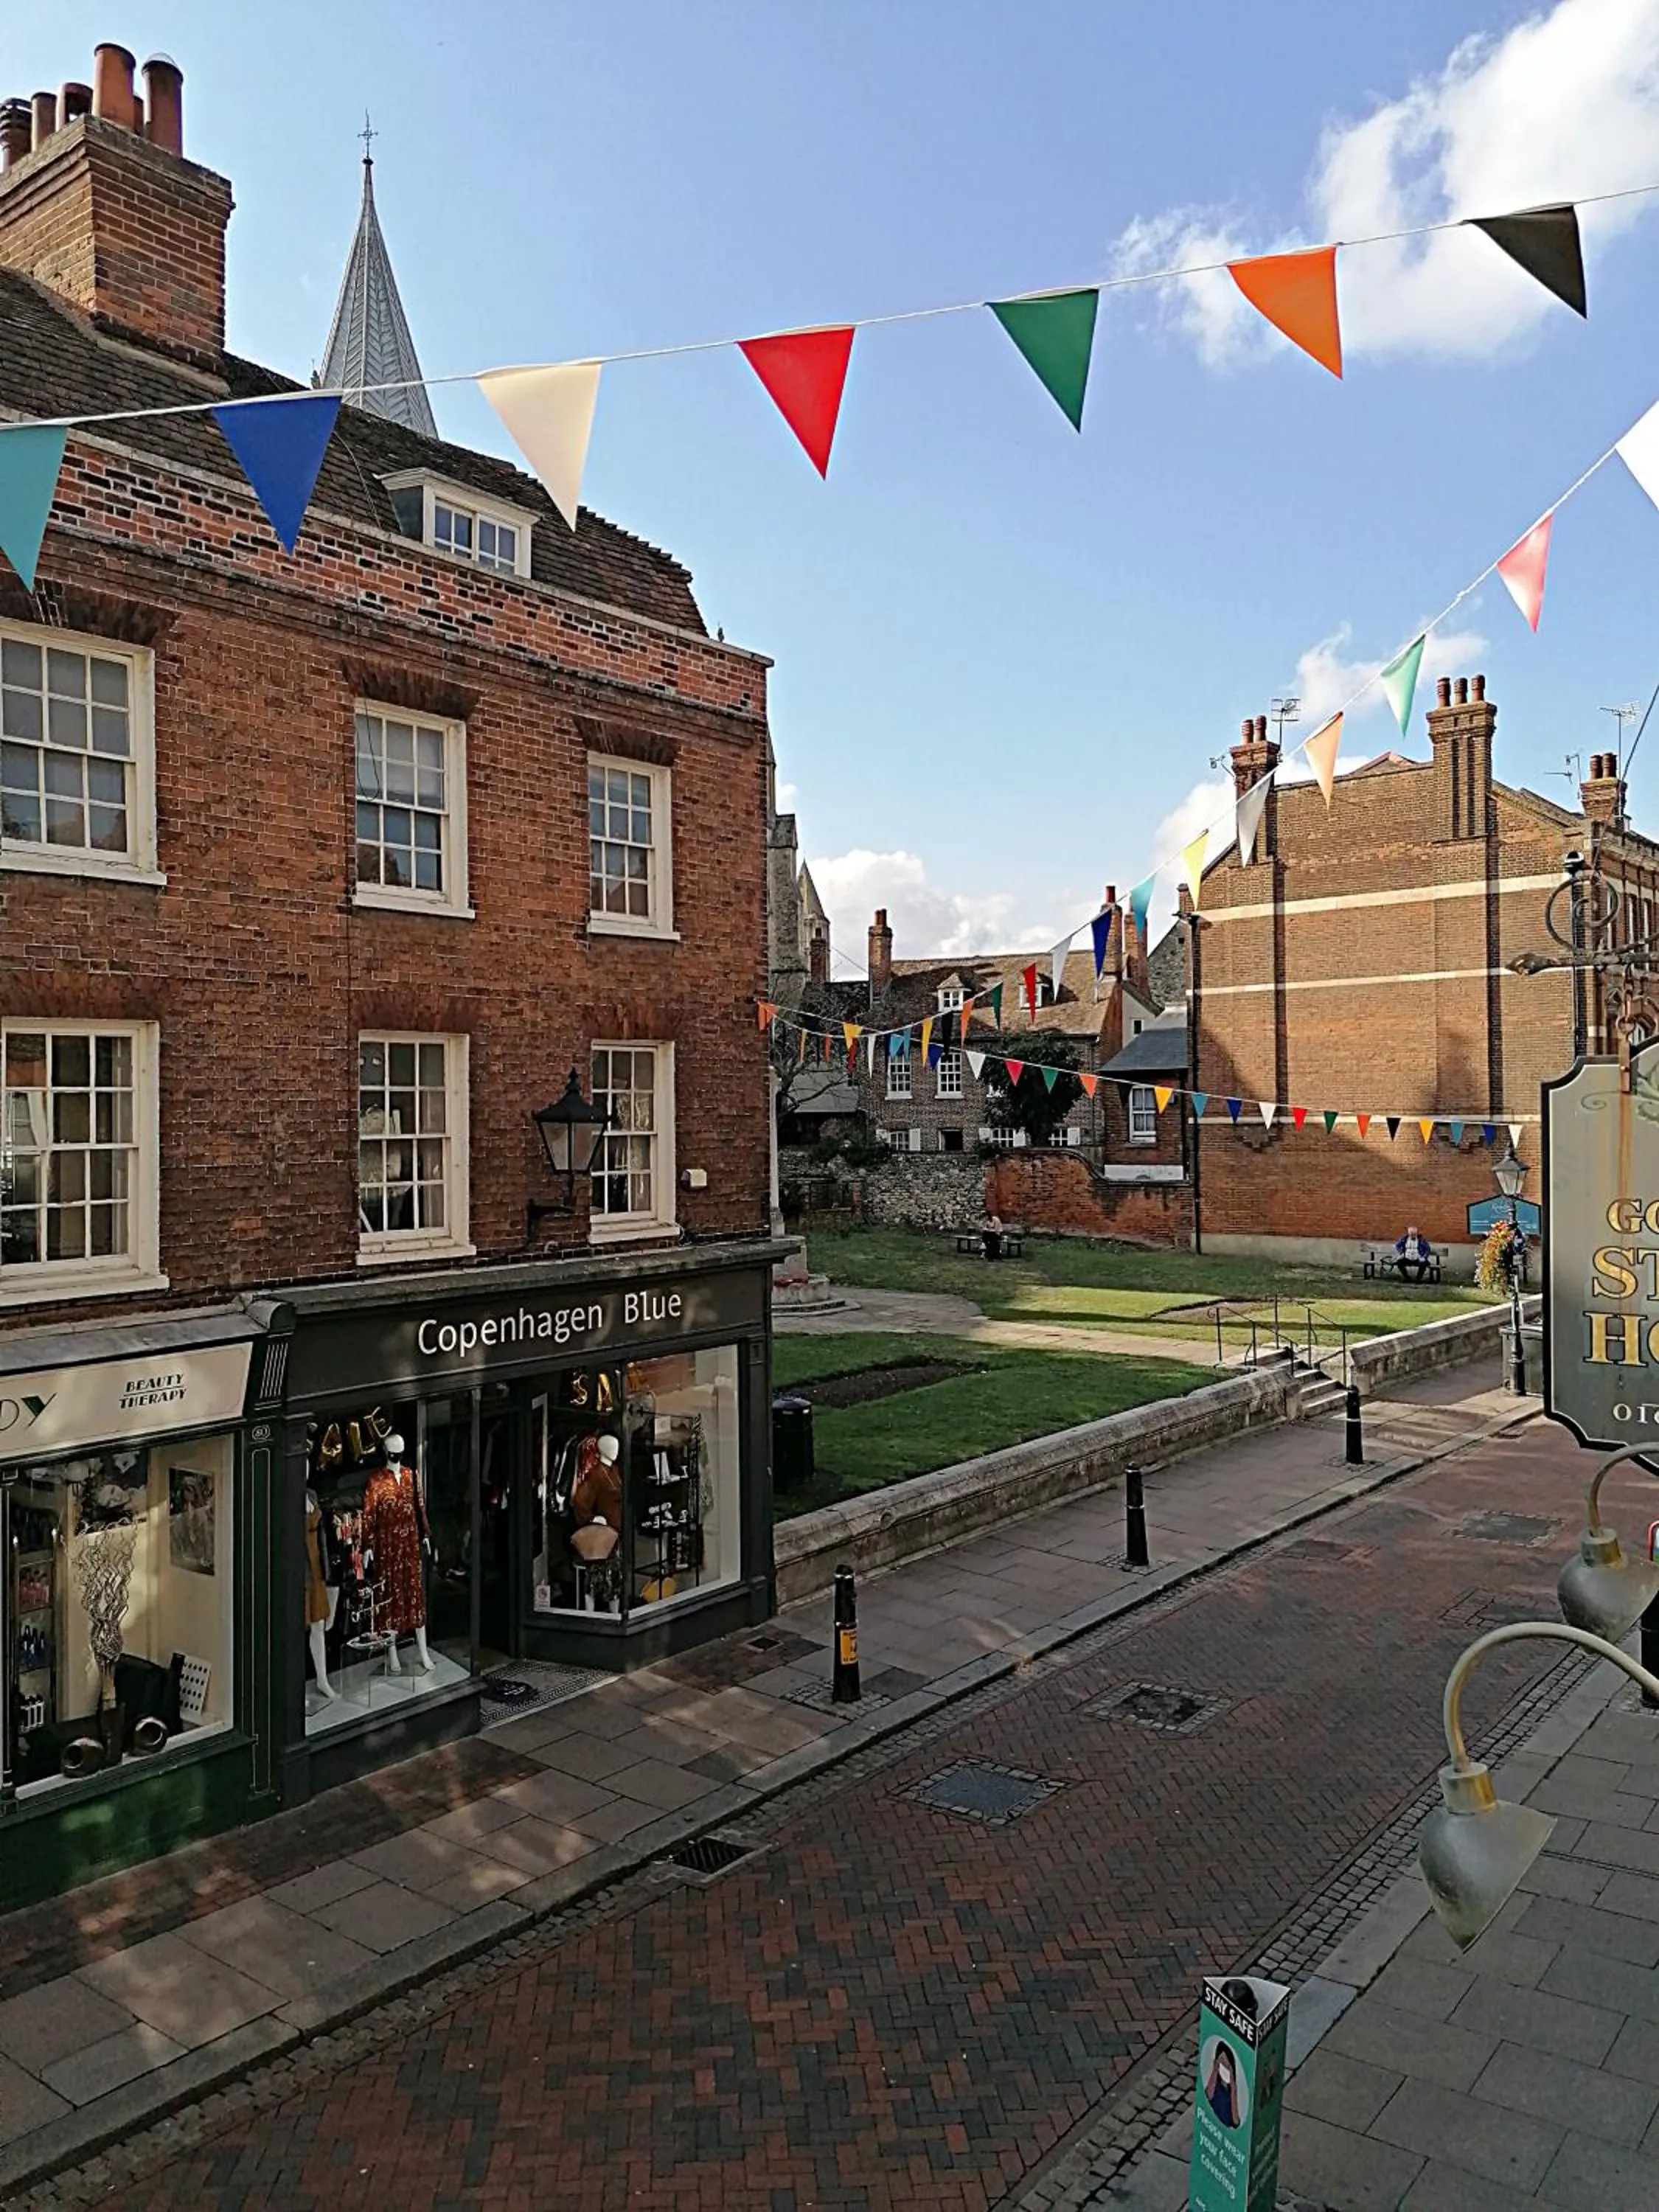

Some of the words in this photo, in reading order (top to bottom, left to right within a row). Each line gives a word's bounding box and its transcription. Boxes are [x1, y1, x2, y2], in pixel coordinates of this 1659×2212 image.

[417, 1304, 603, 1357] Copenhagen
[624, 1291, 682, 1324] Blue
[119, 1388, 187, 1409] THERAPY
[125, 1374, 183, 1393] BEAUTY
[1205, 1987, 1228, 2016] STAY
[1229, 2009, 1253, 2042] SAFE
